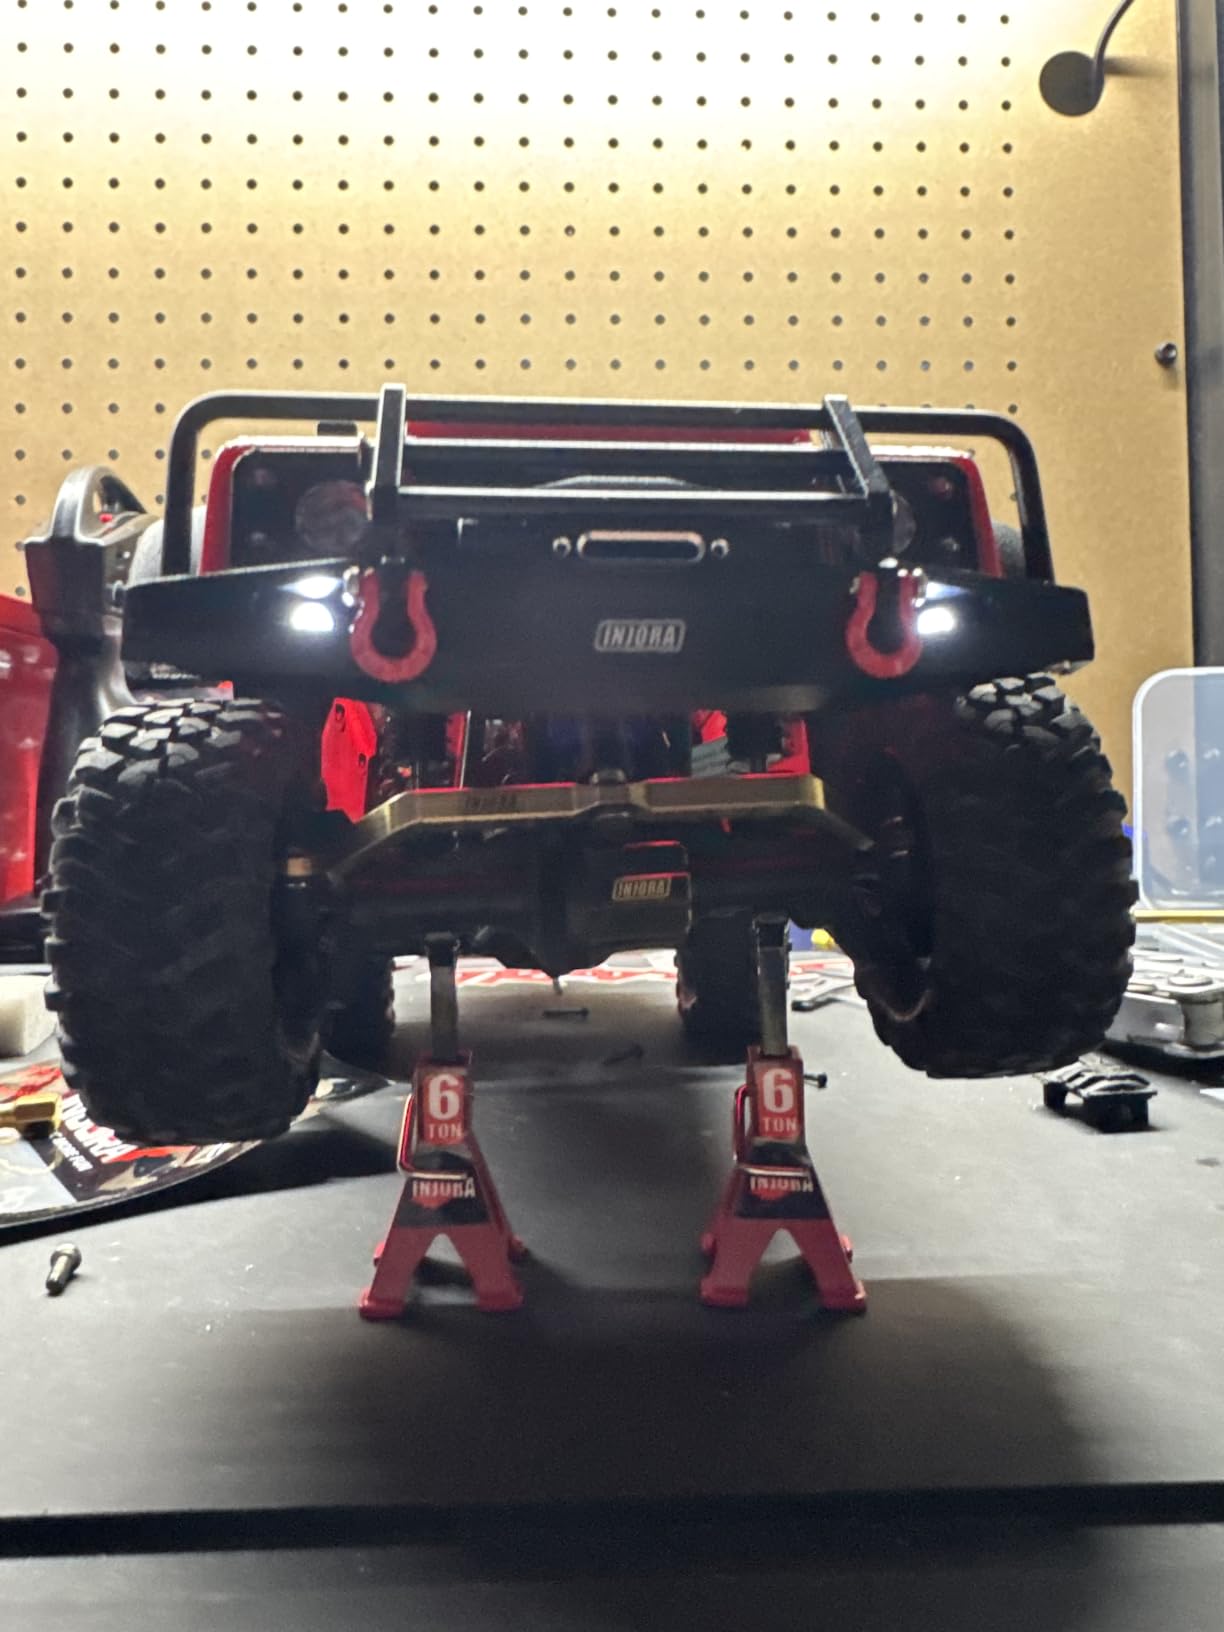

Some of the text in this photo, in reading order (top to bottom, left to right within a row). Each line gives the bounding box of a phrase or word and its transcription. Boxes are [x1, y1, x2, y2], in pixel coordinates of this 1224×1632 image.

[602, 623, 677, 649] INJORA
[617, 879, 666, 898] INJORA
[428, 1073, 460, 1120] 6
[763, 1067, 794, 1113] 6
[428, 1123, 464, 1139] TON
[763, 1116, 798, 1133] TON
